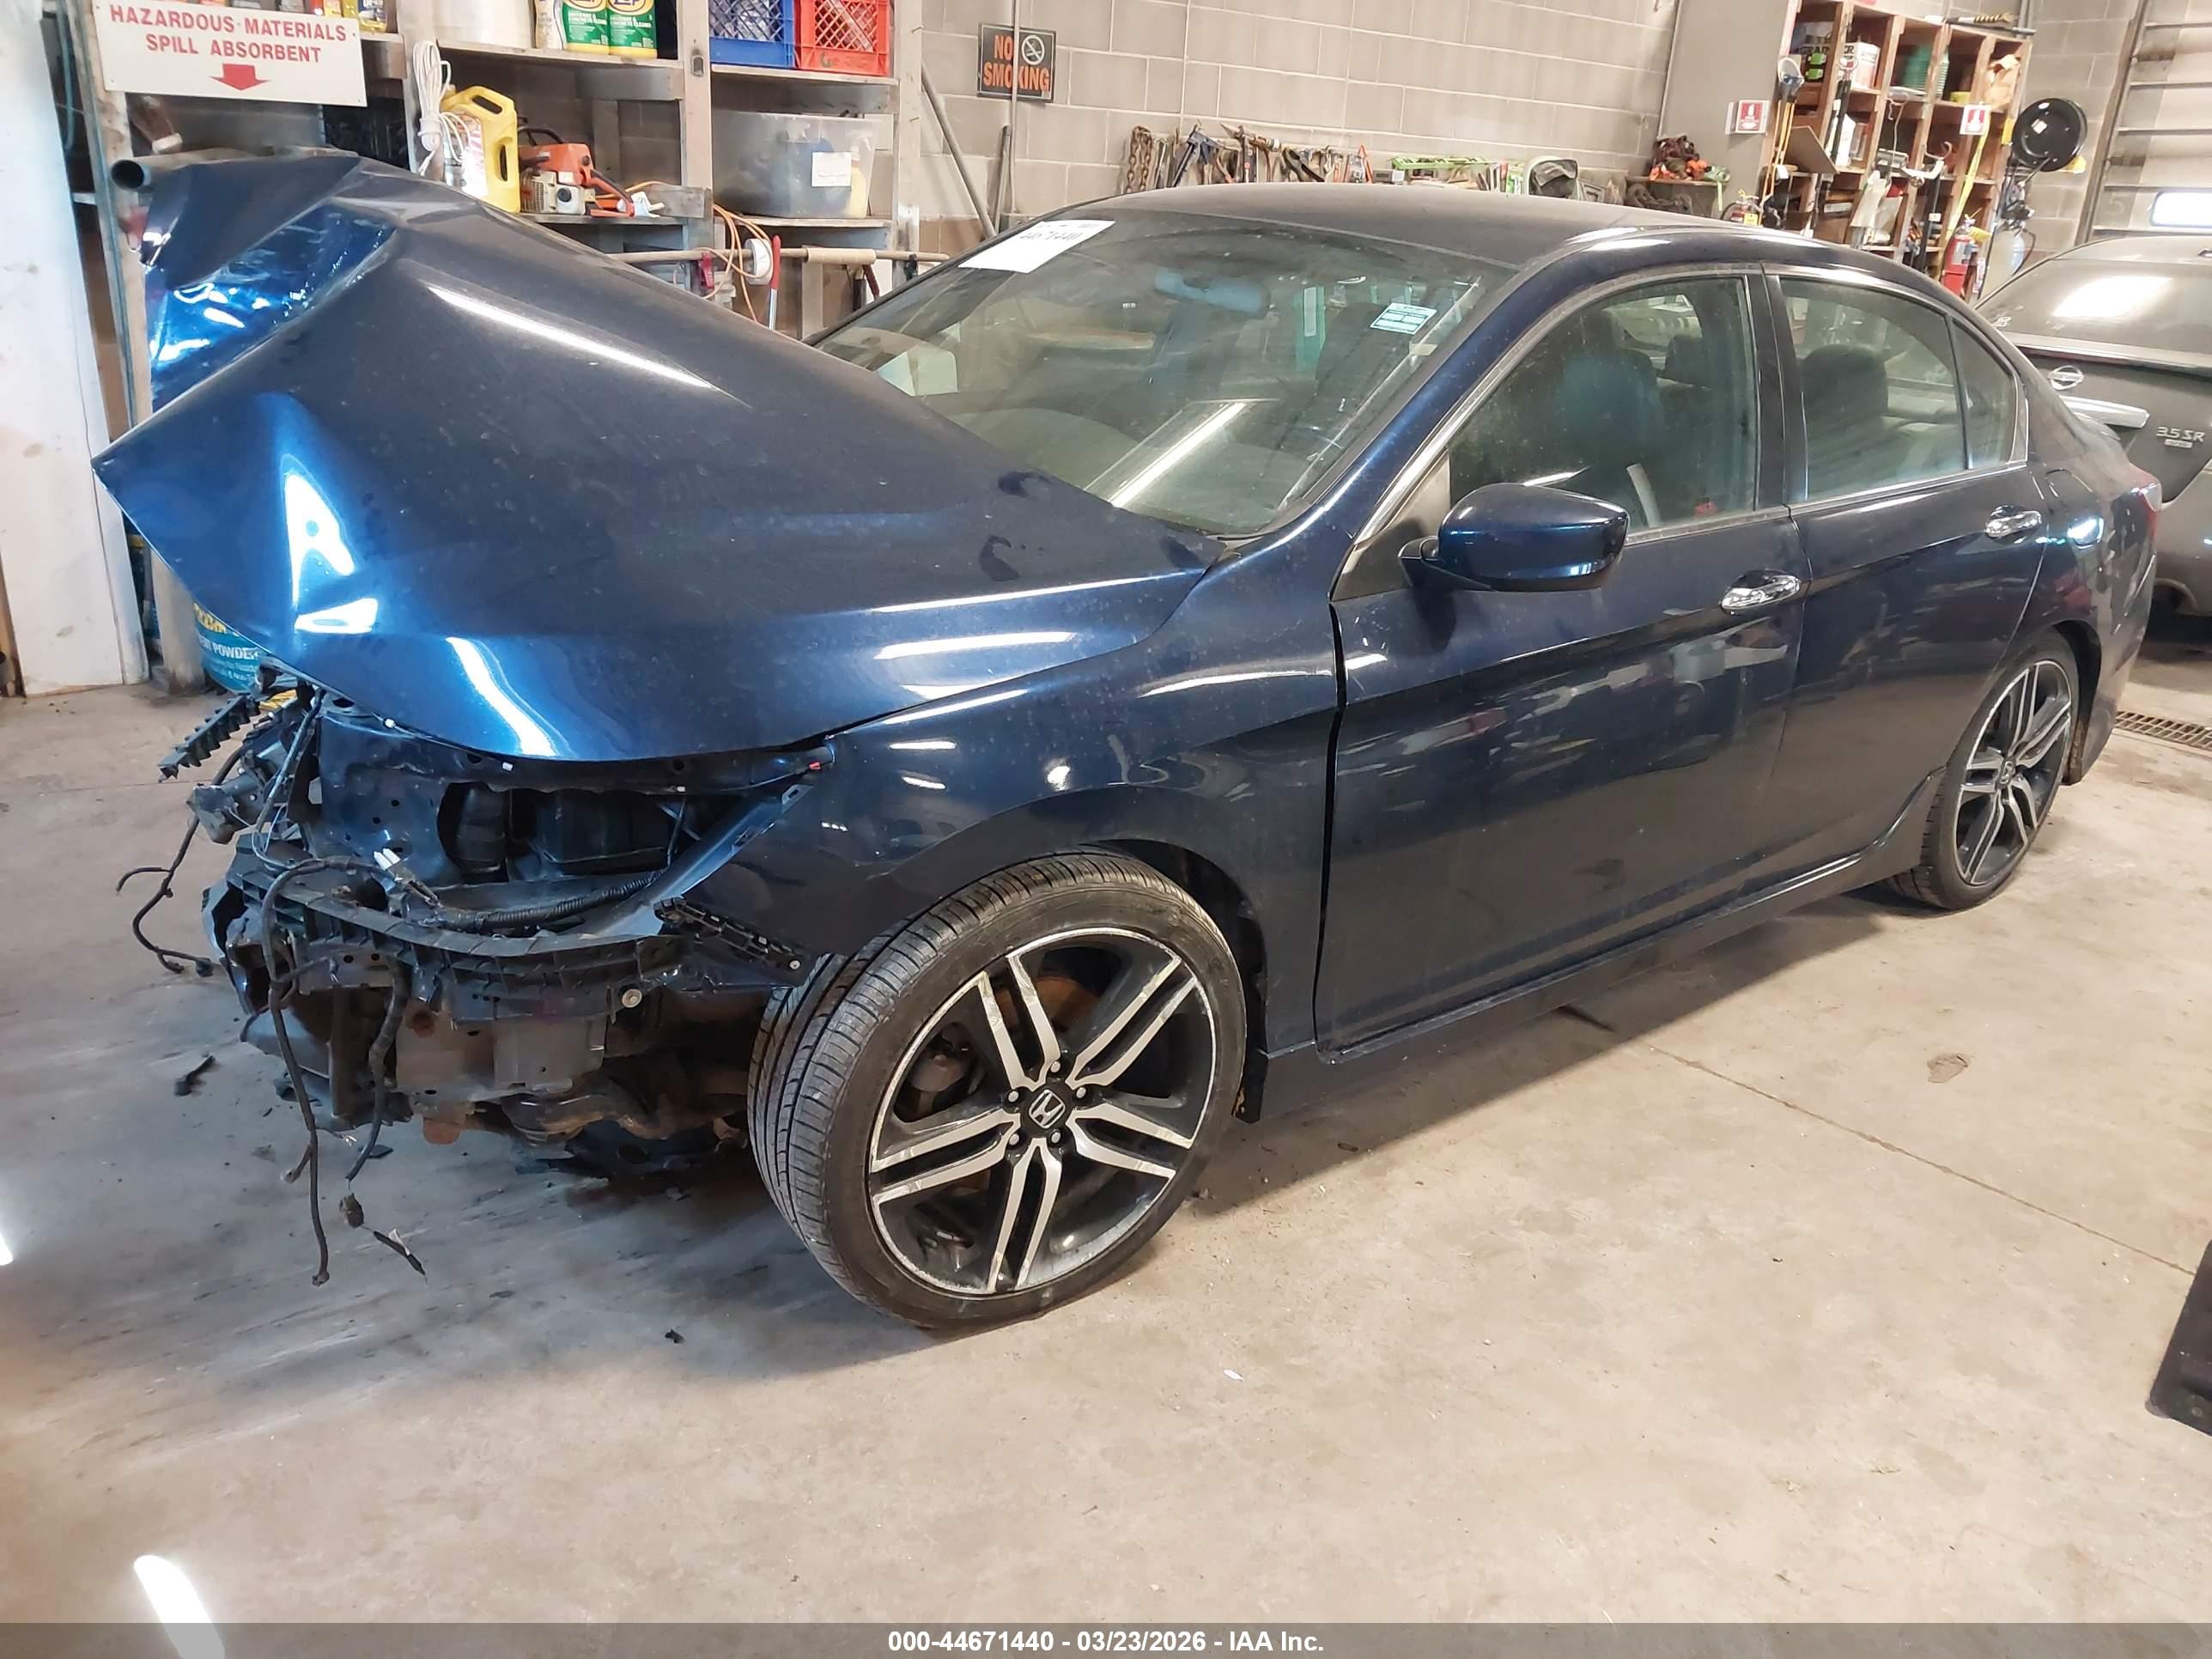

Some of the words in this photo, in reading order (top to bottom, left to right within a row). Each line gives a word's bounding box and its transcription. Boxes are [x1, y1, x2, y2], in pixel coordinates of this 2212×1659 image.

[110, 5, 234, 33] HAZARDOUS
[245, 18, 347, 41] MATERIALS
[144, 33, 199, 54] SPILL
[210, 39, 321, 63] ABSORBENT
[994, 34, 1013, 60] NO
